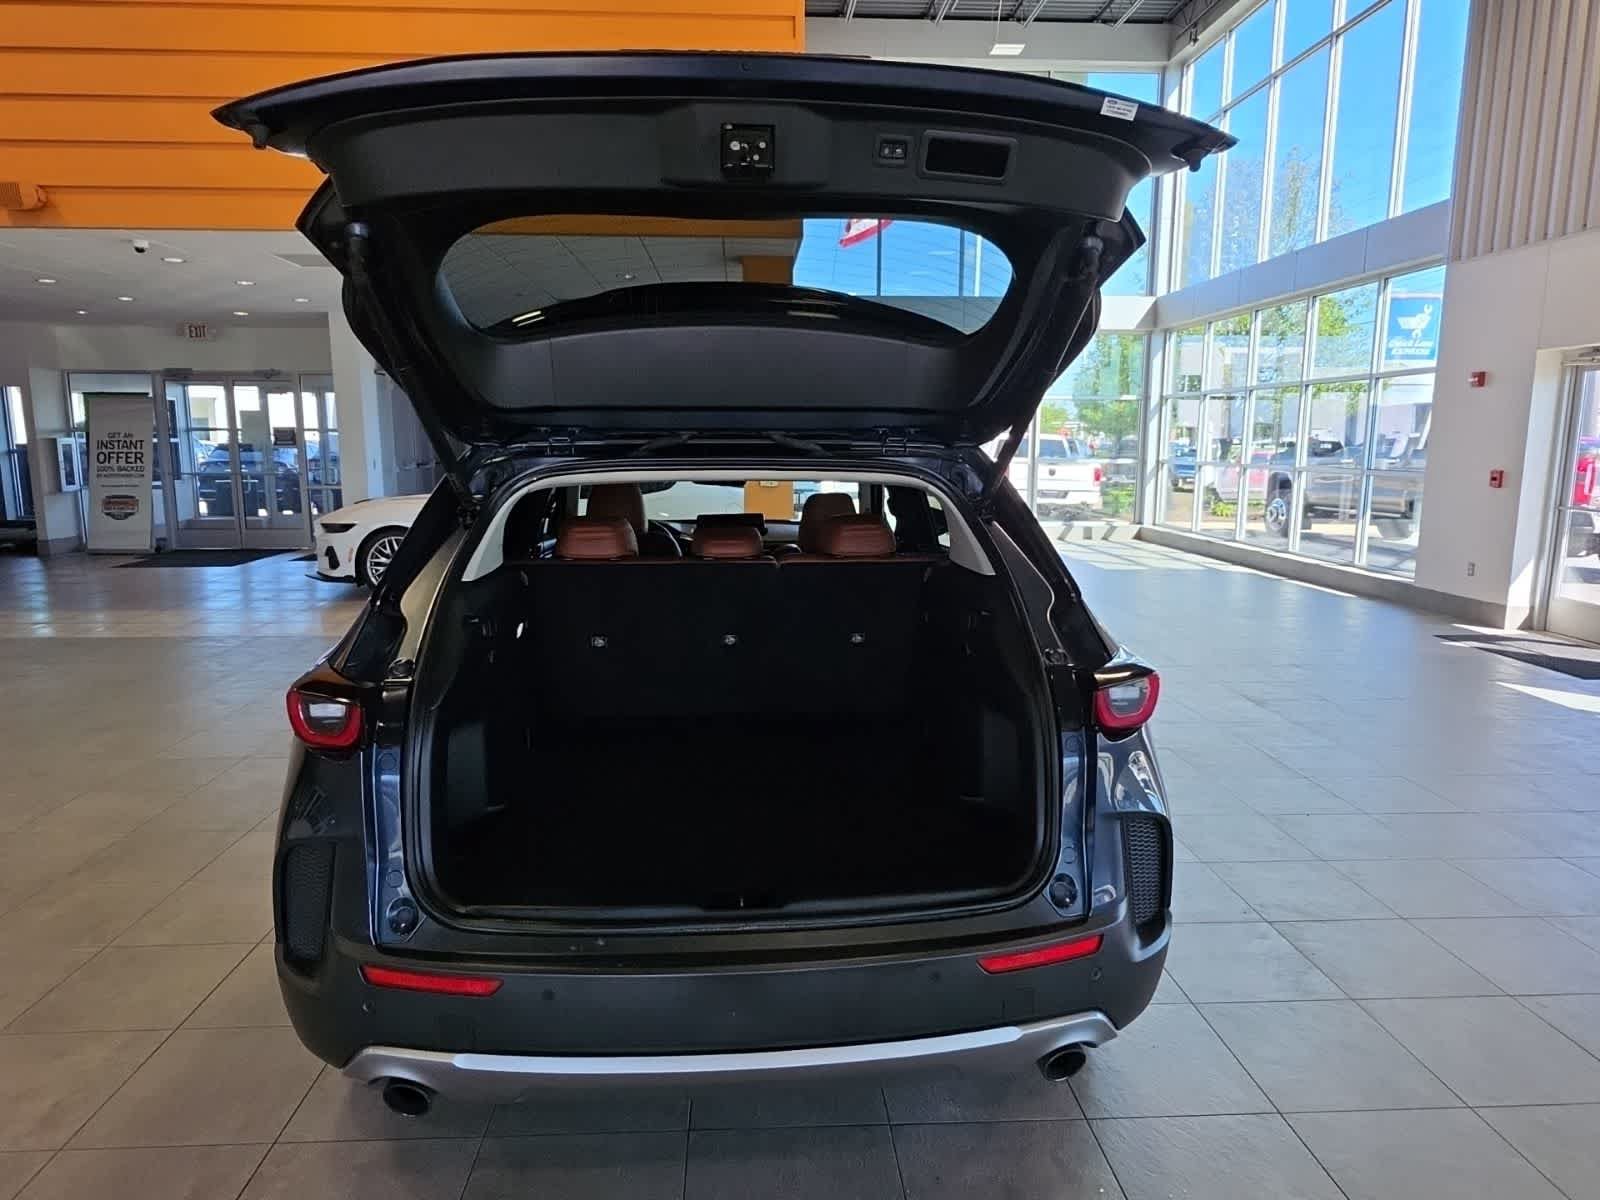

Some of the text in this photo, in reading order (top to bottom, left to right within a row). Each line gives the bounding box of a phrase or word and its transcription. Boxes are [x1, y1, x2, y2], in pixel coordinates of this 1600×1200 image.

[188, 325, 206, 338] EXIT
[96, 439, 145, 450] INSTANT
[96, 451, 145, 465] OFFER
[117, 465, 145, 473] BACKED
